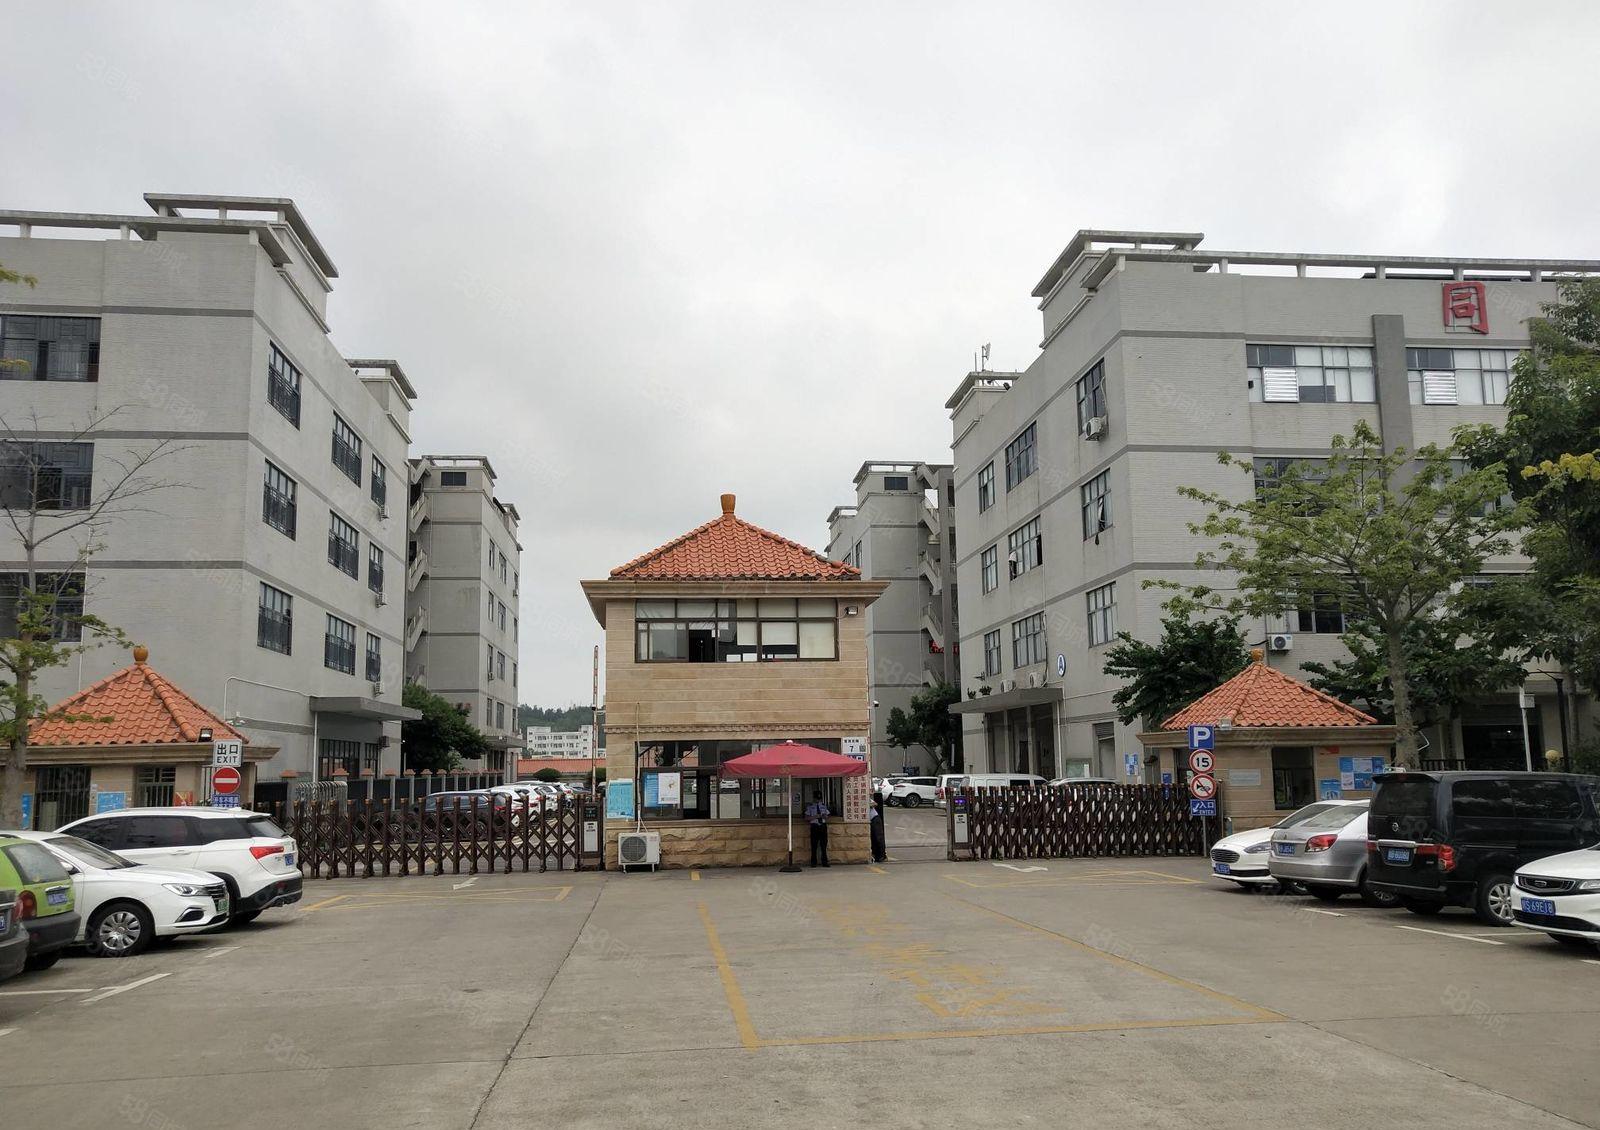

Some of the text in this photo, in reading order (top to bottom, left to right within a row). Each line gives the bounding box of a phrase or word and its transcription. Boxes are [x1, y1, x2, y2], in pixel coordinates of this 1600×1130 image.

[1193, 726, 1211, 748] P
[217, 743, 238, 755] 出口
[217, 756, 238, 764] EXIT
[1196, 757, 1210, 768] 15
